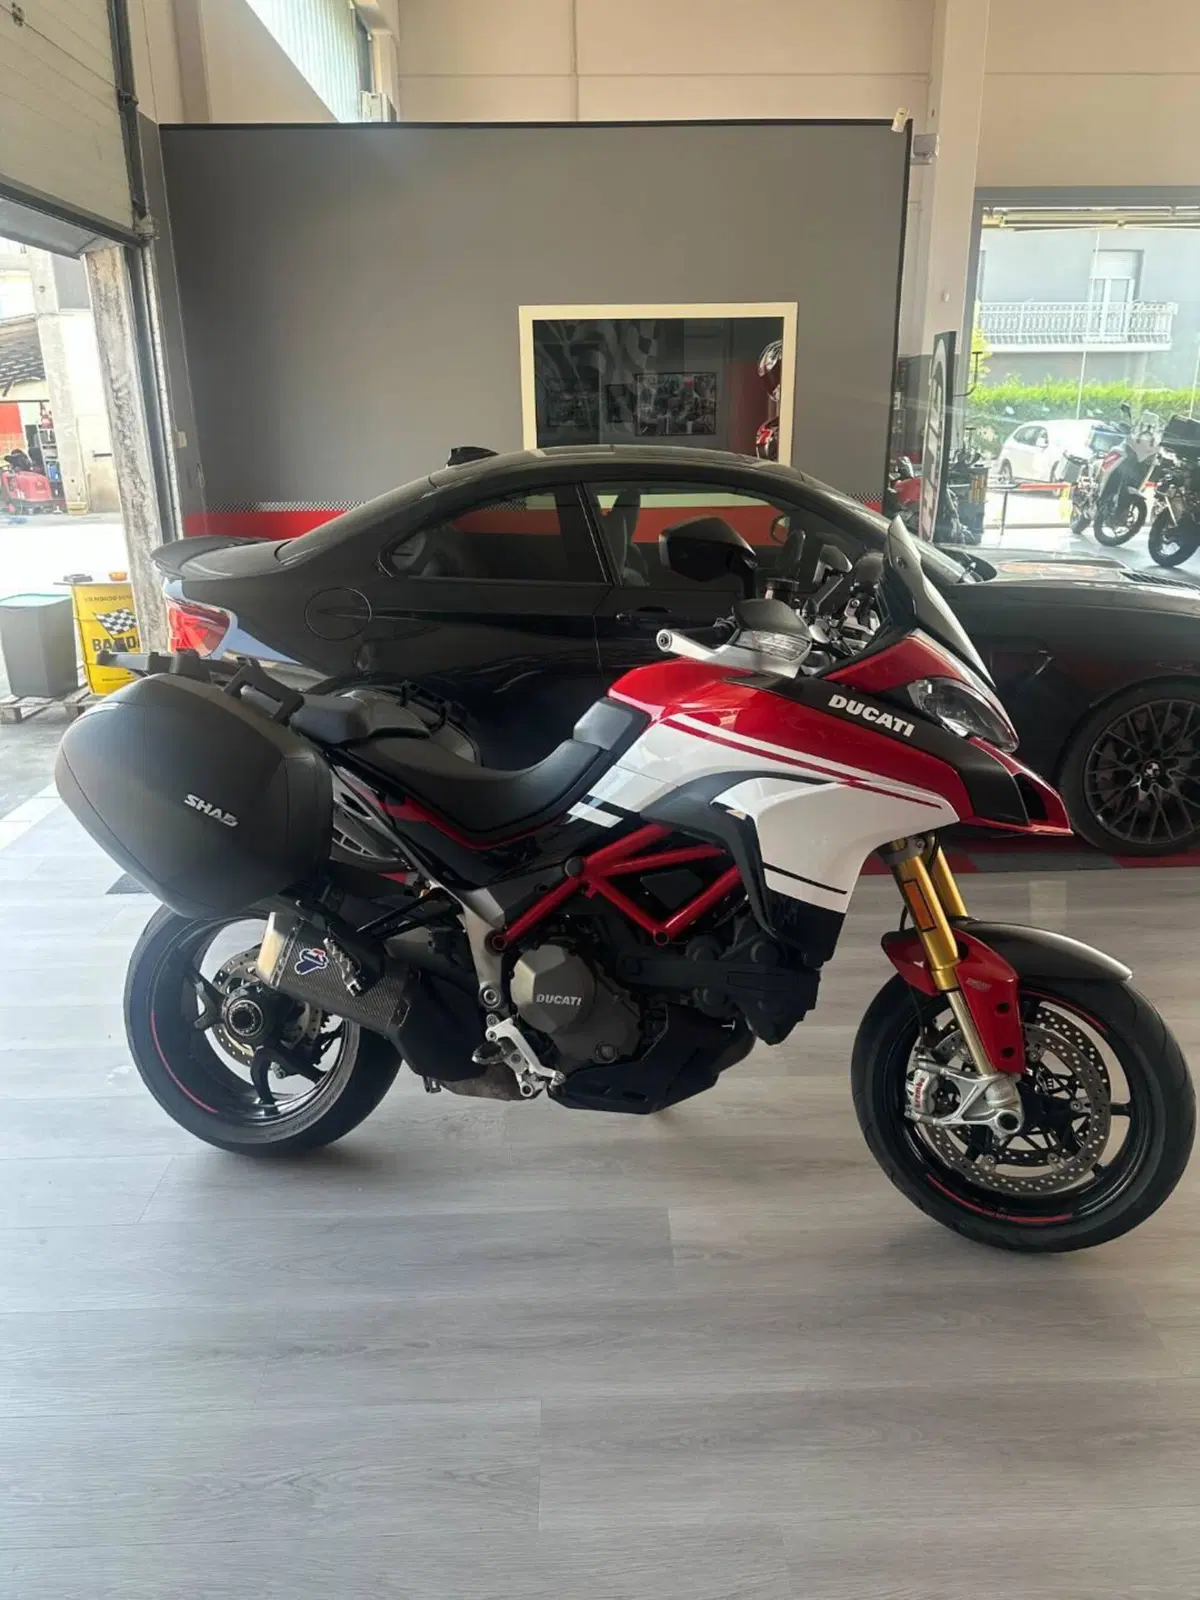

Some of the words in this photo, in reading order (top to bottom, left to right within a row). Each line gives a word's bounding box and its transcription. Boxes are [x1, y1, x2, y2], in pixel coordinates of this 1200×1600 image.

[92, 636, 141, 652] BAD
[827, 694, 915, 737] DUCATI
[184, 794, 239, 827] SHAD
[536, 993, 582, 1006] DUCATI
